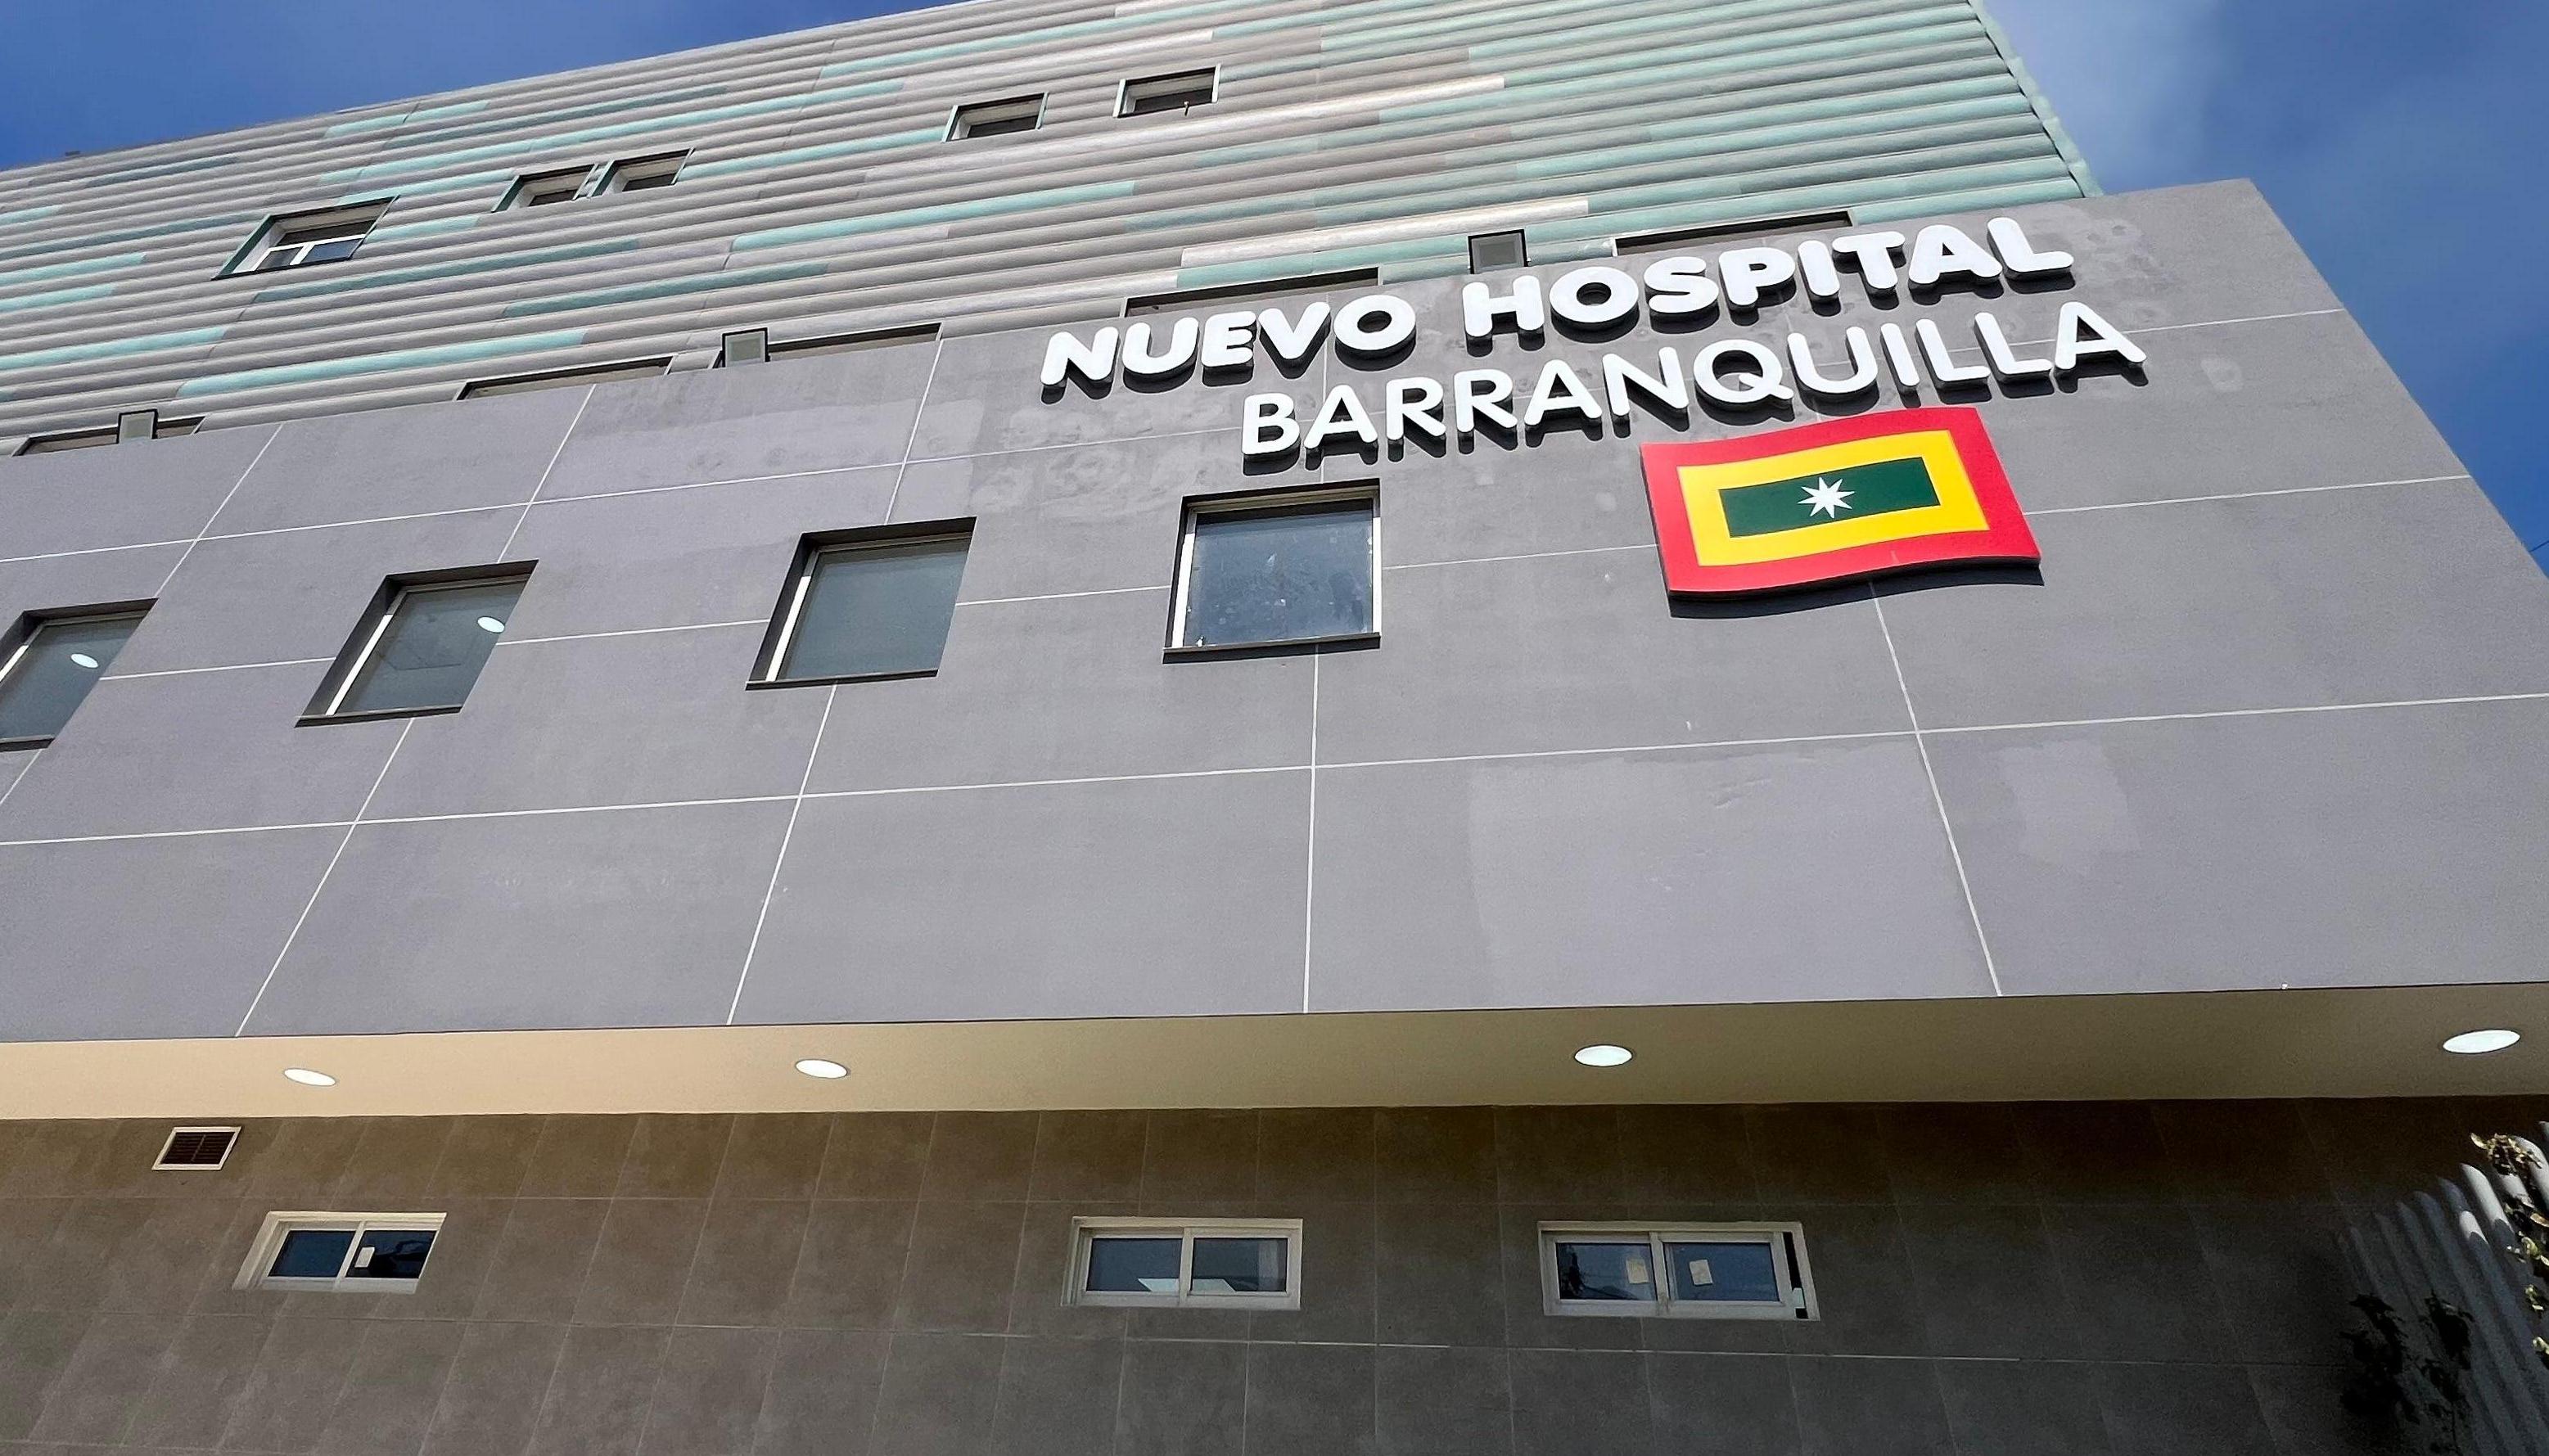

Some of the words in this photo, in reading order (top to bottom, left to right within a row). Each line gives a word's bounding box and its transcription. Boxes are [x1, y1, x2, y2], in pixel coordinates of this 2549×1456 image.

[1040, 294, 1416, 386] NUEVO
[1462, 217, 2074, 338] HOSPITAL
[1242, 301, 2146, 455] BARRANQUILLA
